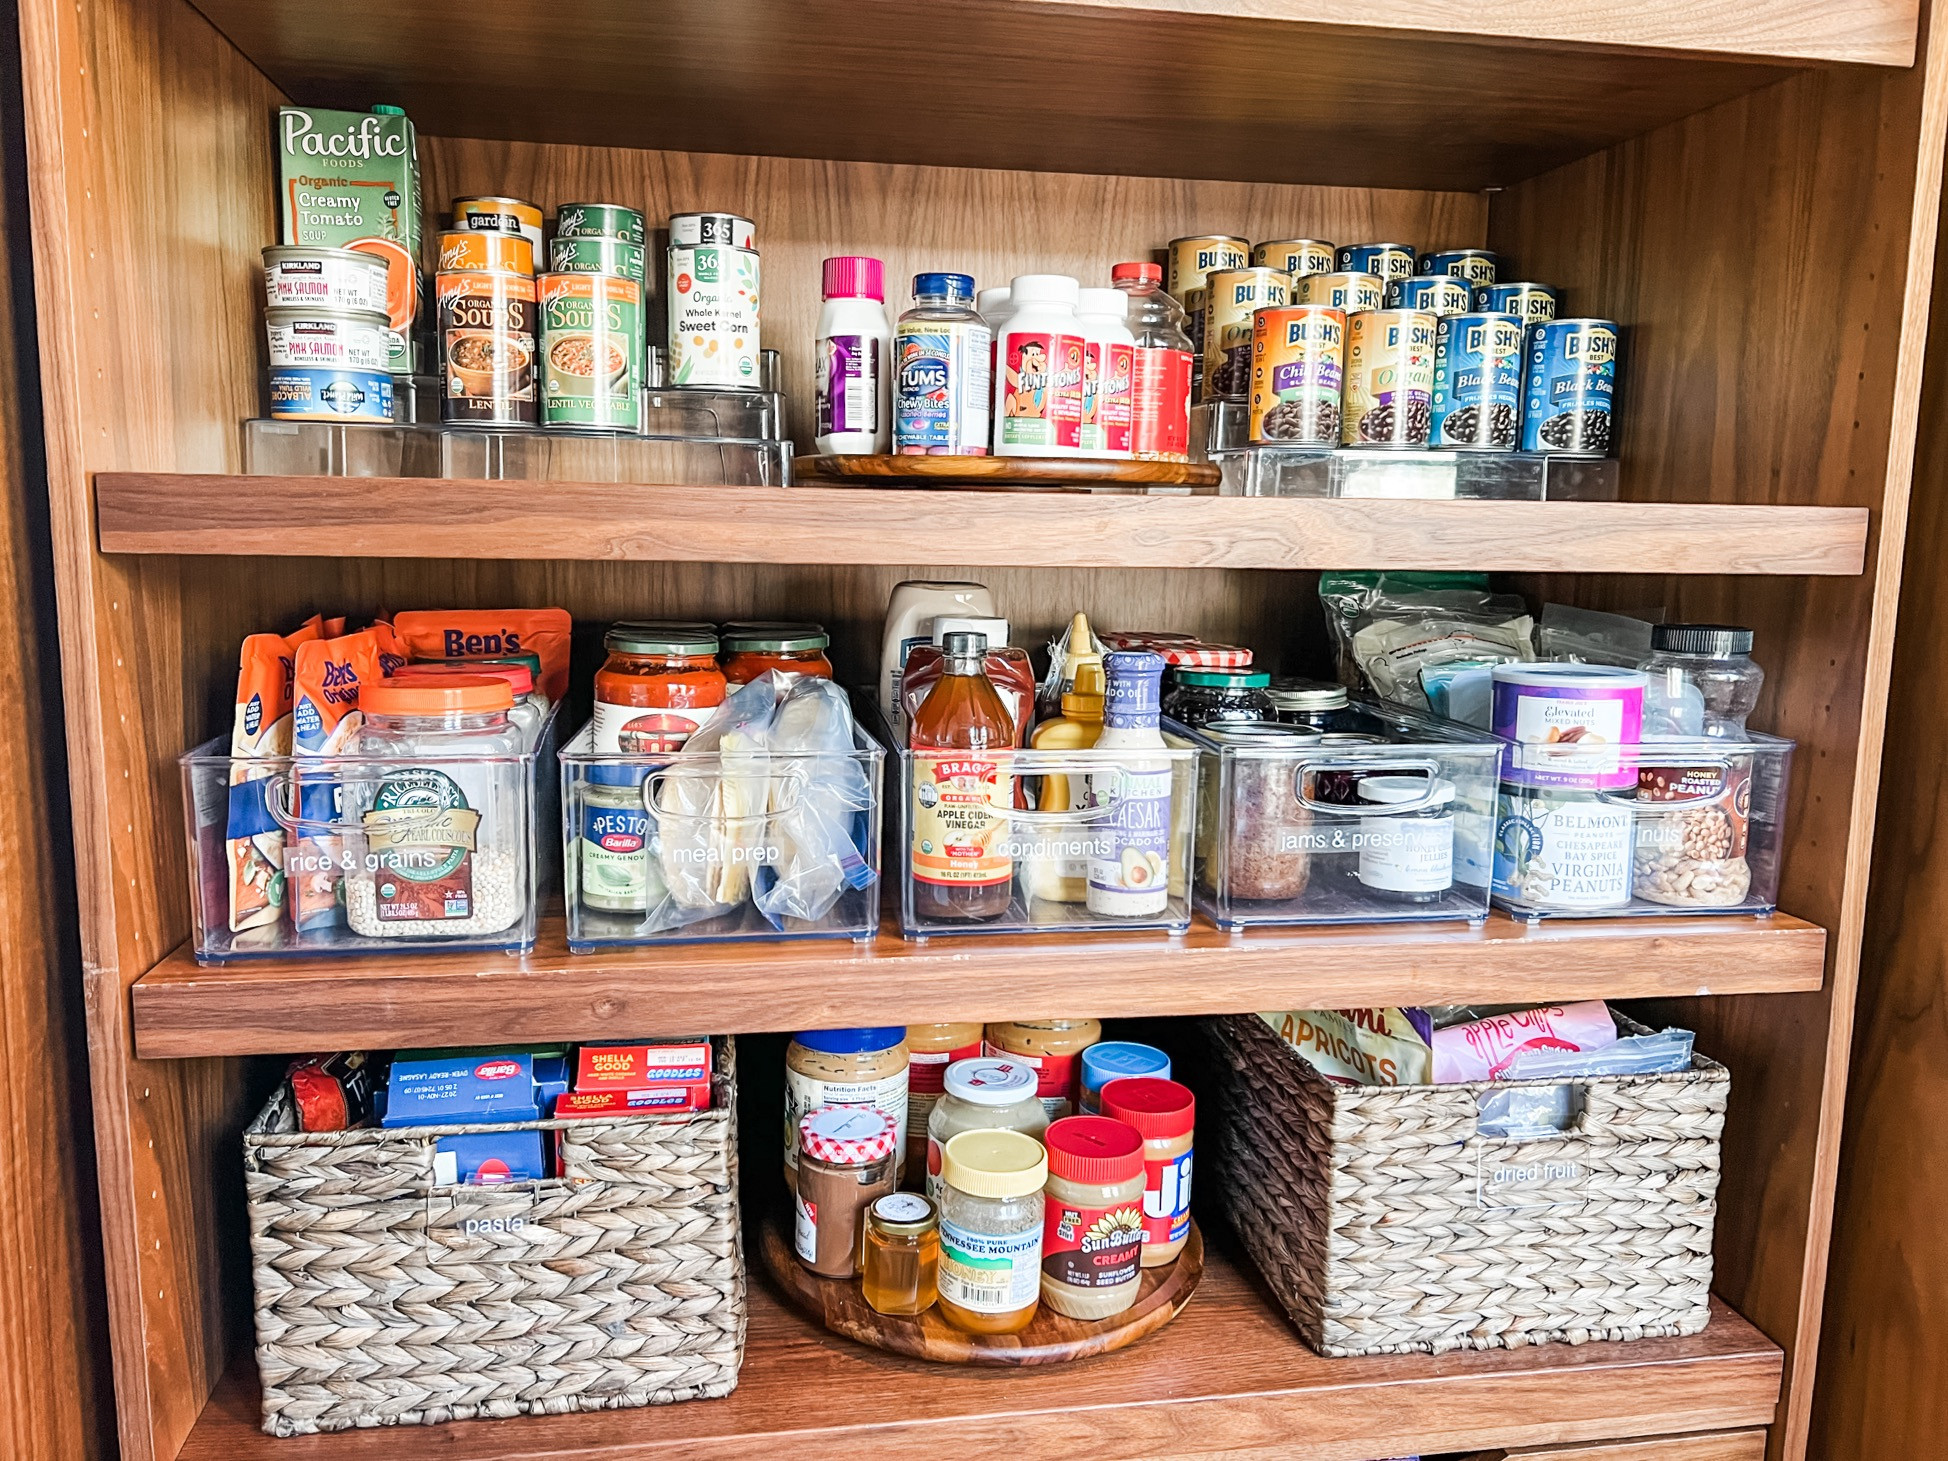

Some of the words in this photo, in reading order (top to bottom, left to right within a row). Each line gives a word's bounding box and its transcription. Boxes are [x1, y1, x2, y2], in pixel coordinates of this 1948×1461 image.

[280, 110, 407, 159] Pacific
[323, 159, 363, 168] FOODS
[299, 175, 349, 190] Organic
[299, 192, 361, 212] Creamy
[300, 211, 363, 226] Tomato
[471, 215, 517, 229] gardein
[559, 210, 586, 237] Amy's
[303, 230, 327, 241] SOUP
[703, 222, 731, 238] 365
[439, 240, 470, 268] Amy's
[282, 262, 321, 270] KIRKLAND
[277, 282, 292, 295] PINK
[294, 282, 328, 295] SALMON
[473, 282, 493, 290] LIGHT
[571, 283, 592, 291] LIGHT
[347, 289, 357, 297] WT
[438, 279, 473, 310] Amy's
[539, 280, 572, 312] Amy's
[686, 309, 712, 318] Whole
[294, 322, 337, 331] KIRKLAND
[679, 320, 716, 332] Sweet
[289, 342, 306, 356] PINK
[309, 342, 344, 357] SALMON
[901, 370, 946, 386] TUMS
[279, 385, 293, 393] TUNA
[293, 385, 311, 393] WILD
[548, 399, 576, 409] LENTIL
[898, 399, 923, 410] Chewy
[924, 399, 950, 409] Bites
[444, 629, 520, 658] Ben's
[1113, 680, 1131, 689] WITH
[298, 709, 315, 717] ADD
[1544, 706, 1595, 718] Elevated
[301, 722, 320, 732] HEAT
[1687, 771, 1717, 779] HONEY
[1681, 777, 1721, 786] ROASTED
[937, 810, 965, 819] APPLE
[1109, 801, 1161, 829] CAESAR
[597, 815, 648, 835] PESTO
[945, 820, 986, 830] VINEGAR
[1554, 814, 1628, 829] BELMONT
[407, 829, 432, 843] PEARL
[432, 829, 472, 844] COUSCOUS
[1642, 827, 1679, 842] nuts
[605, 837, 639, 848] Barilla
[1281, 831, 1326, 852] jams
[1331, 830, 1346, 848] &
[1556, 840, 1623, 850] CHESAPEAKE
[998, 837, 1112, 858] condiments
[291, 853, 332, 872] rice
[340, 850, 357, 870] &
[365, 849, 436, 872] grains
[589, 852, 615, 861] CREAMY
[673, 846, 725, 864] meal
[732, 846, 779, 865] prep
[1420, 852, 1448, 863] JELLIES
[1564, 851, 1587, 860] BAY
[1591, 851, 1617, 860] SPICE
[950, 860, 978, 870] Honey
[1551, 862, 1624, 877] VIRGINIA
[1549, 878, 1623, 893] PEANUTS
[1281, 1014, 1397, 1086] APRICOTS
[592, 1054, 634, 1063] SHELLA
[478, 1065, 516, 1077] Barilla
[594, 1063, 630, 1071] GOOD
[399, 1073, 427, 1081] LASAGNE
[429, 1070, 468, 1080] OVEN-READY
[647, 1068, 702, 1079] GOODLES
[823, 1085, 856, 1093] Nutrition
[857, 1085, 877, 1093] Facts
[627, 1098, 684, 1107] GOODLES
[1494, 1164, 1538, 1183] dried
[1543, 1162, 1577, 1179] fruit
[804, 1202, 815, 1218] NEW
[1065, 1210, 1079, 1218] NUT
[465, 1216, 525, 1236] pasta
[1064, 1216, 1080, 1224] FREE
[1061, 1223, 1072, 1232] NO
[966, 1237, 985, 1245] 100%
[988, 1236, 1041, 1254] MOUNTAIN
[1093, 1245, 1139, 1266] CREAMY
[943, 1257, 998, 1284] HONEY
[1099, 1264, 1135, 1279] SUNFLOWER
[1096, 1278, 1114, 1286] SEED
[1115, 1271, 1136, 1284] BUTTER
